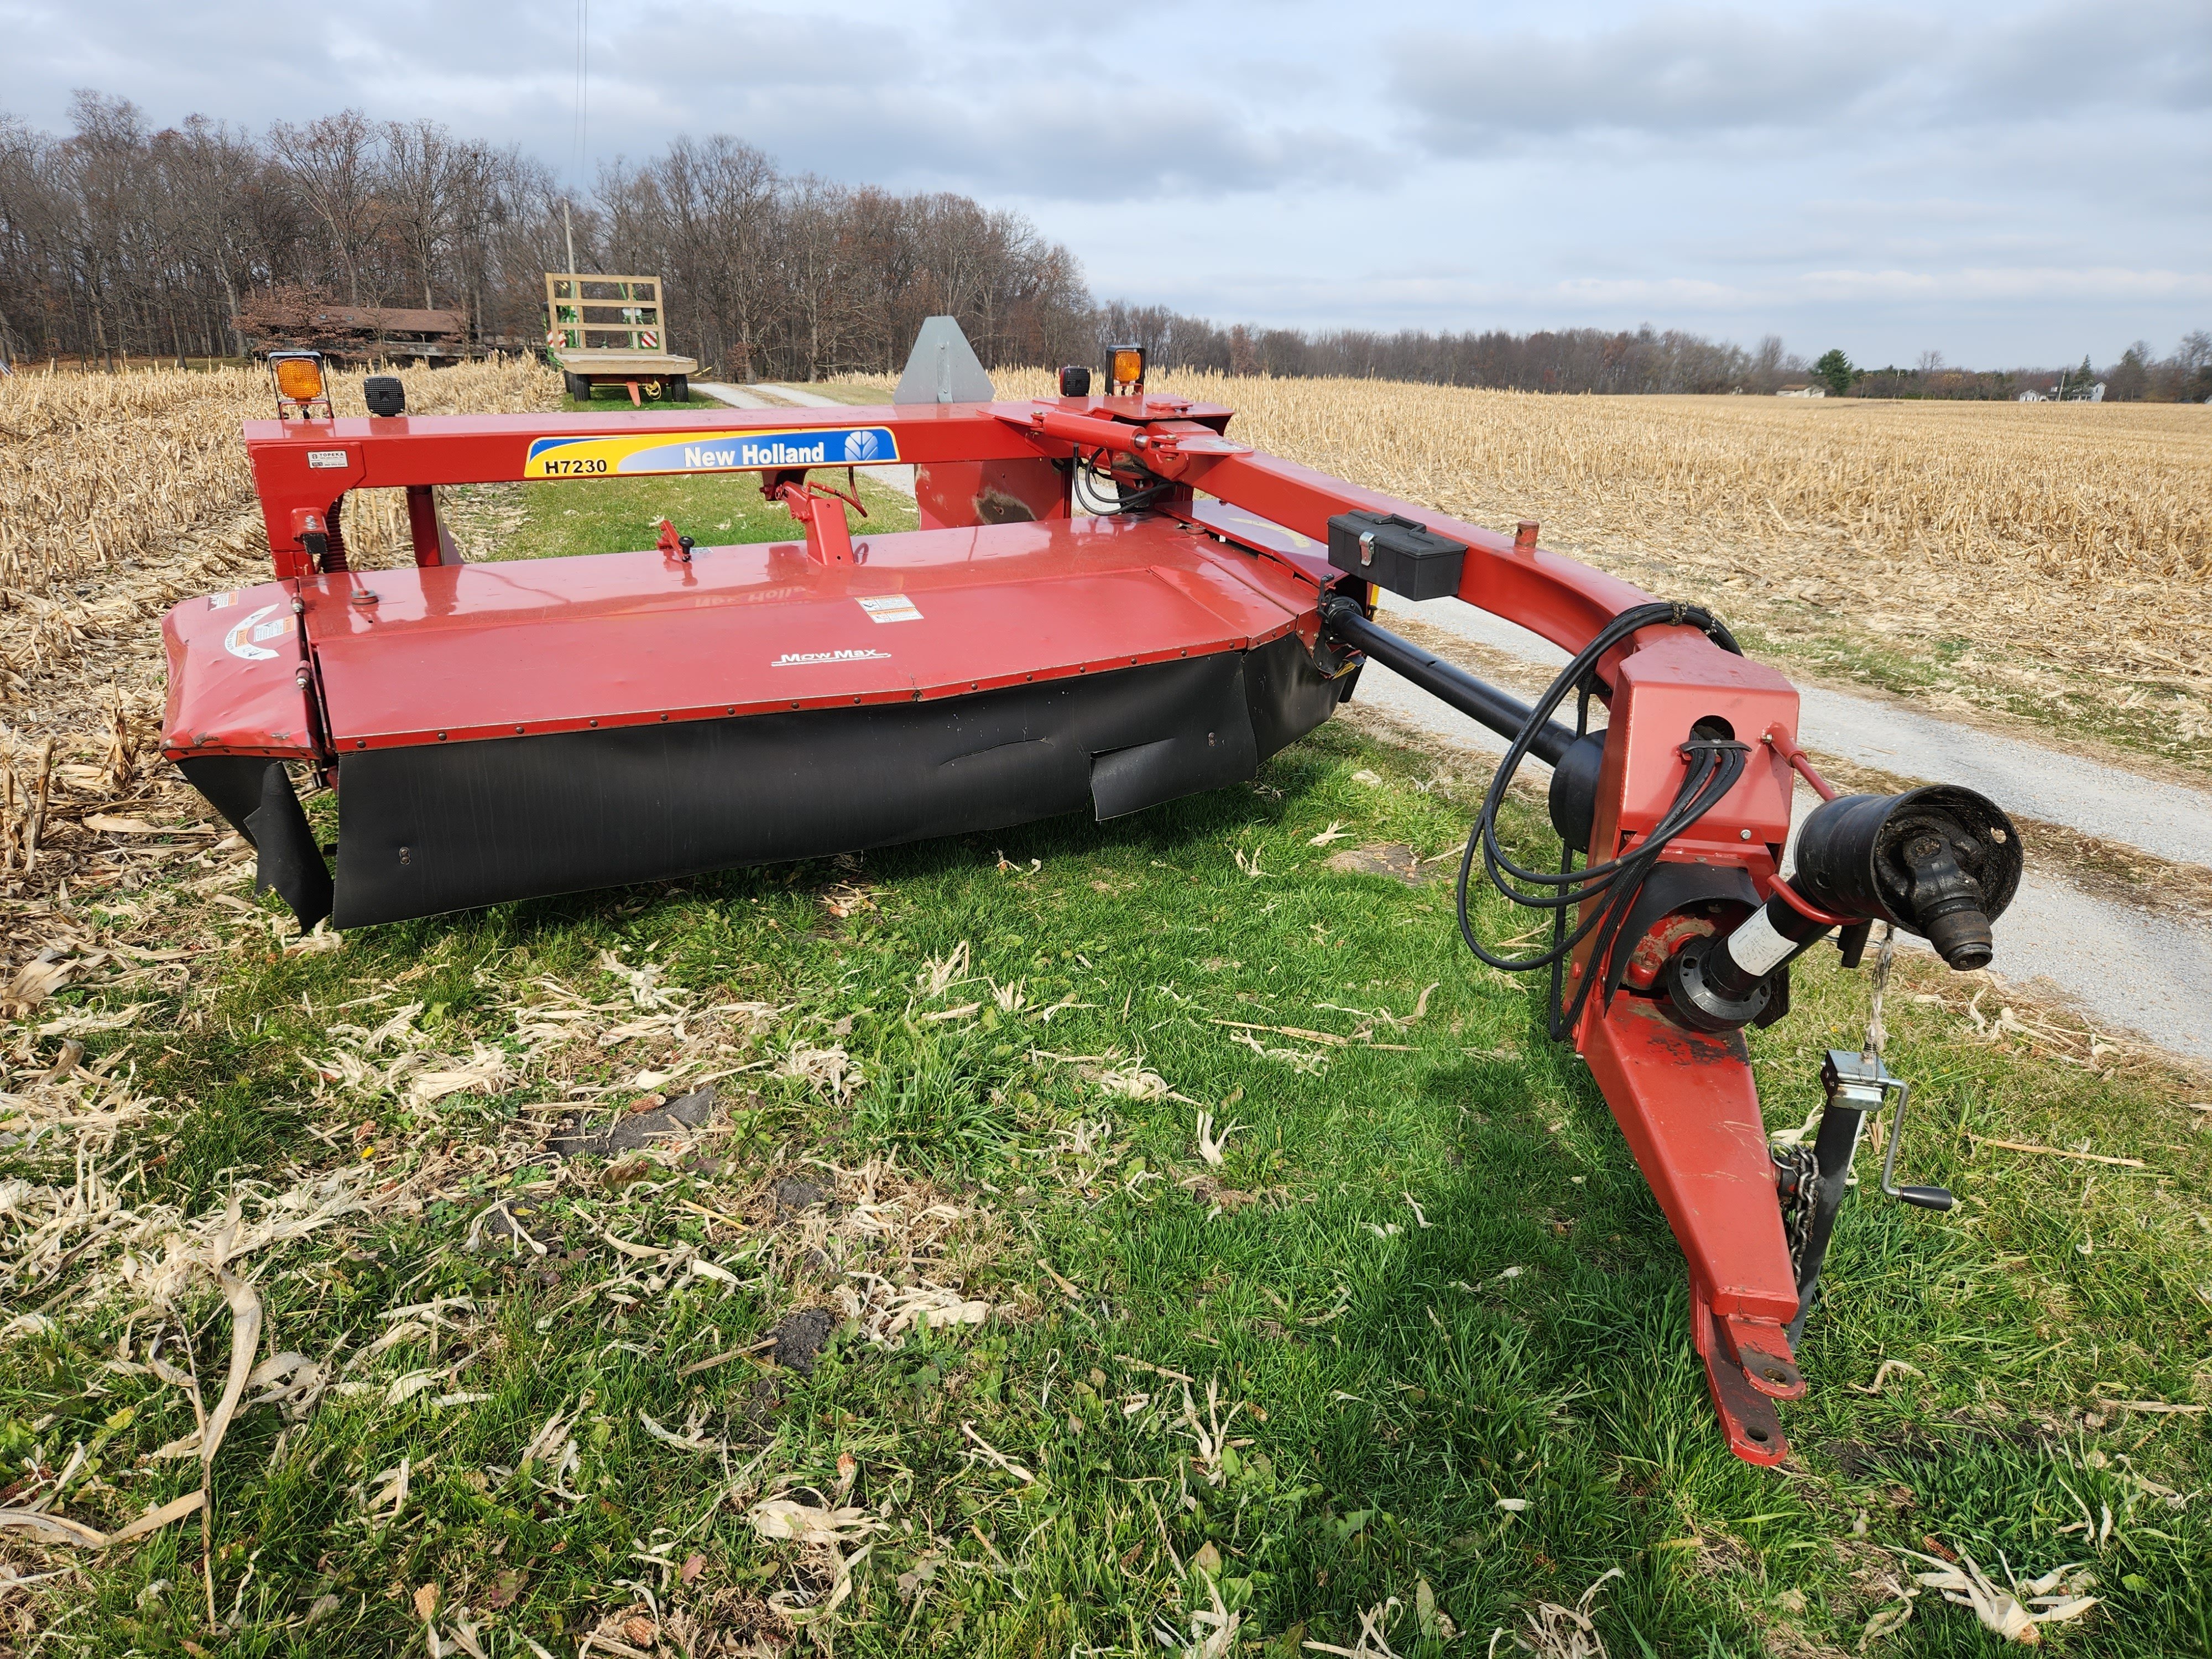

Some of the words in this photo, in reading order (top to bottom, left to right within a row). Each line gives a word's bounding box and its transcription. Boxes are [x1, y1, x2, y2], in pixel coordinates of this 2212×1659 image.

[545, 460, 607, 474] H7230
[684, 447, 735, 467] New
[742, 442, 824, 465] Holland
